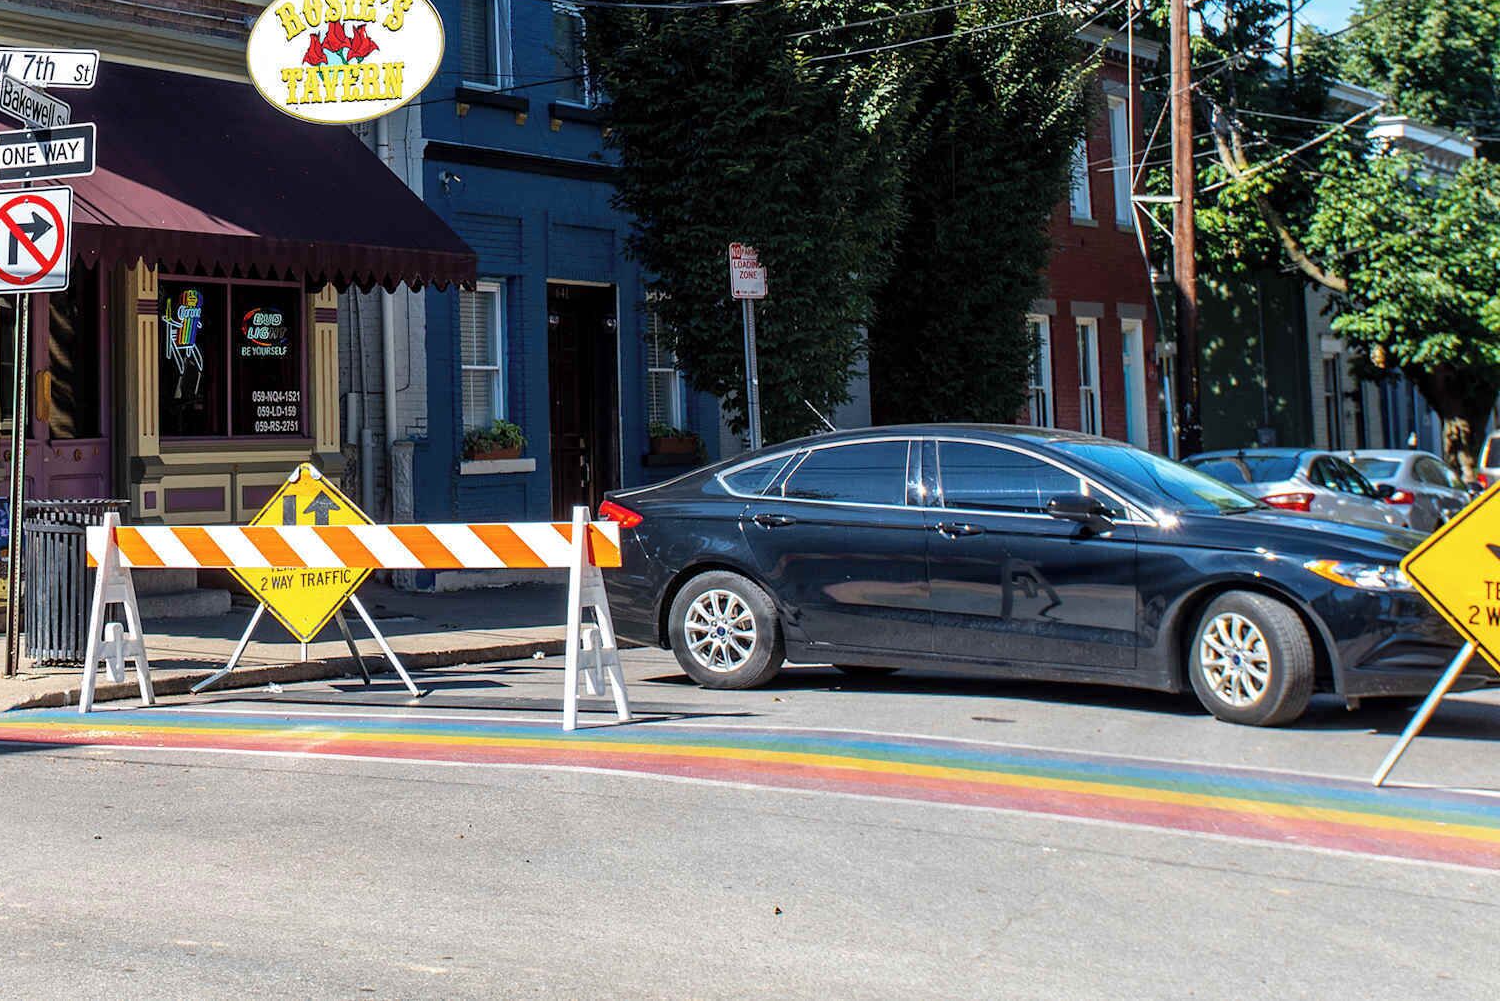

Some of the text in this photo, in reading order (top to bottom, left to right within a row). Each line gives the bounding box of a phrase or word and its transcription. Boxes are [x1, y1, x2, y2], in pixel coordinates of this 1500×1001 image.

[23, 54, 56, 81] 7th
[74, 64, 91, 82] St
[281, 61, 405, 105] TAVERN
[3, 79, 56, 128] Bakewell
[2, 141, 80, 166] ONE WAY
[732, 246, 741, 258] NO
[740, 270, 757, 279] ZONE
[253, 312, 282, 326] BUD
[241, 346, 288, 356] BE YOURSELF
[260, 569, 352, 592] 2 WAY TRAFFIC
[1468, 605, 1481, 625] 2
